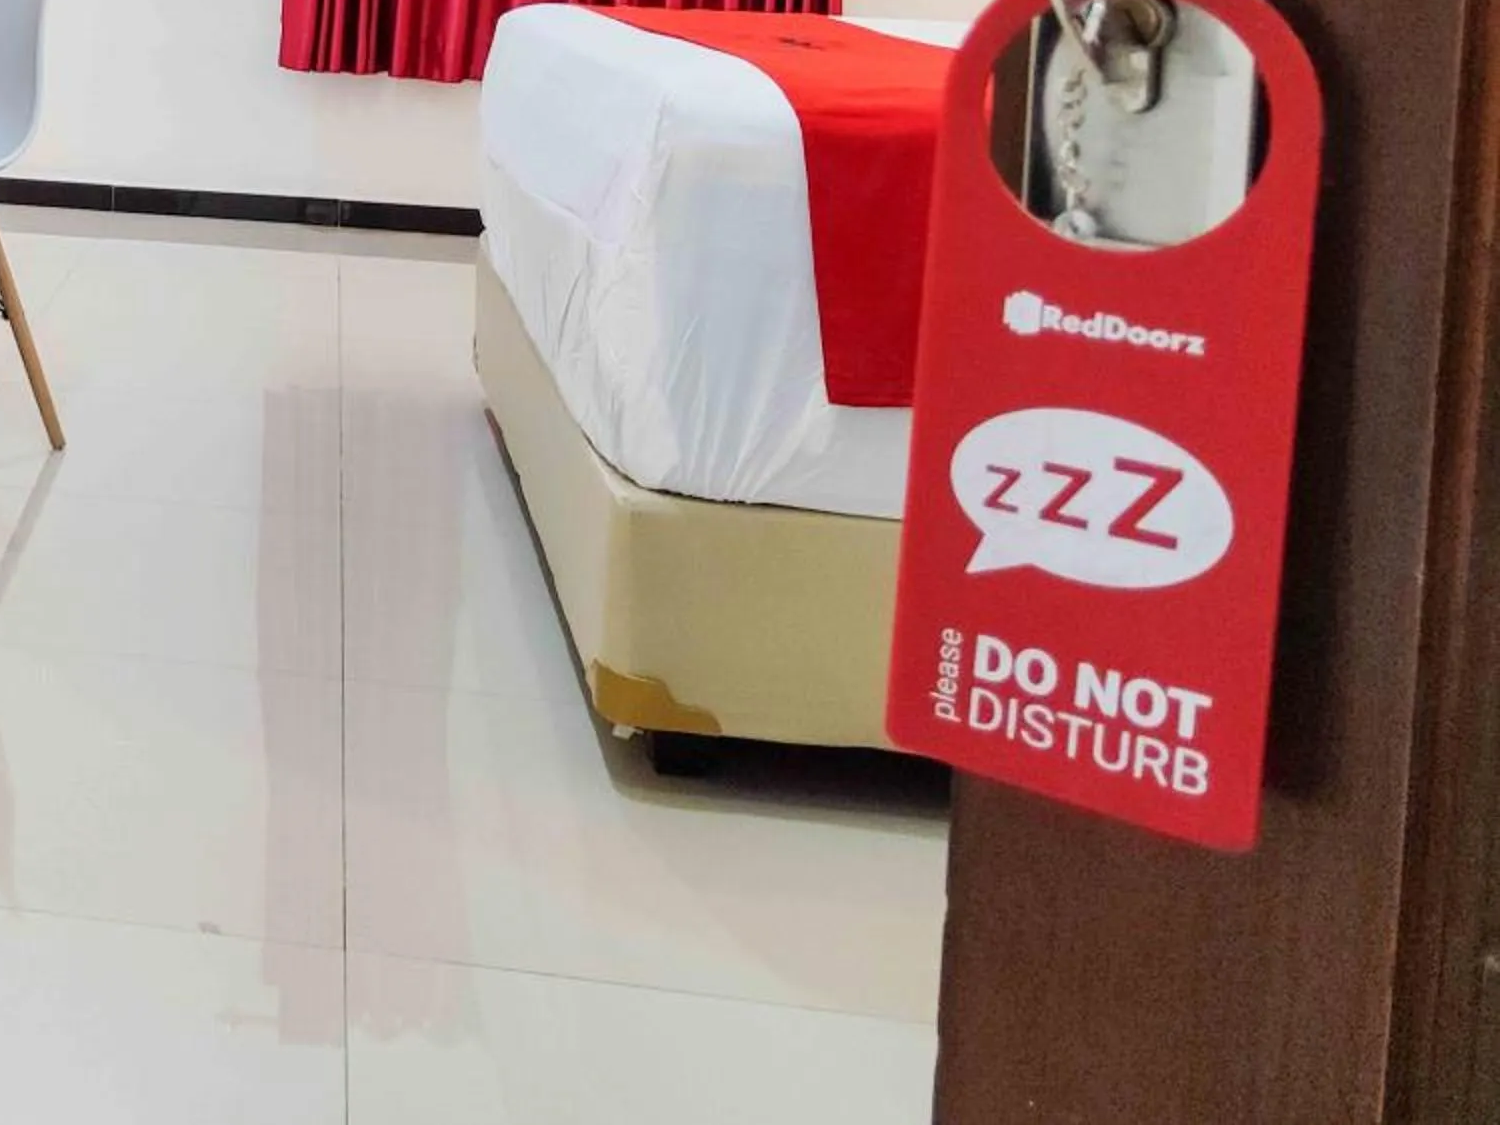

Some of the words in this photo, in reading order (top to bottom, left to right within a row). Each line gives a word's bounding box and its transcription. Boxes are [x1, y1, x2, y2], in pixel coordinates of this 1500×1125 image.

[1040, 303, 1206, 356] RedDoorz
[930, 627, 964, 722] please
[973, 634, 1058, 695] DO
[1074, 662, 1213, 740] NOT
[967, 687, 1210, 796] DISTURB
